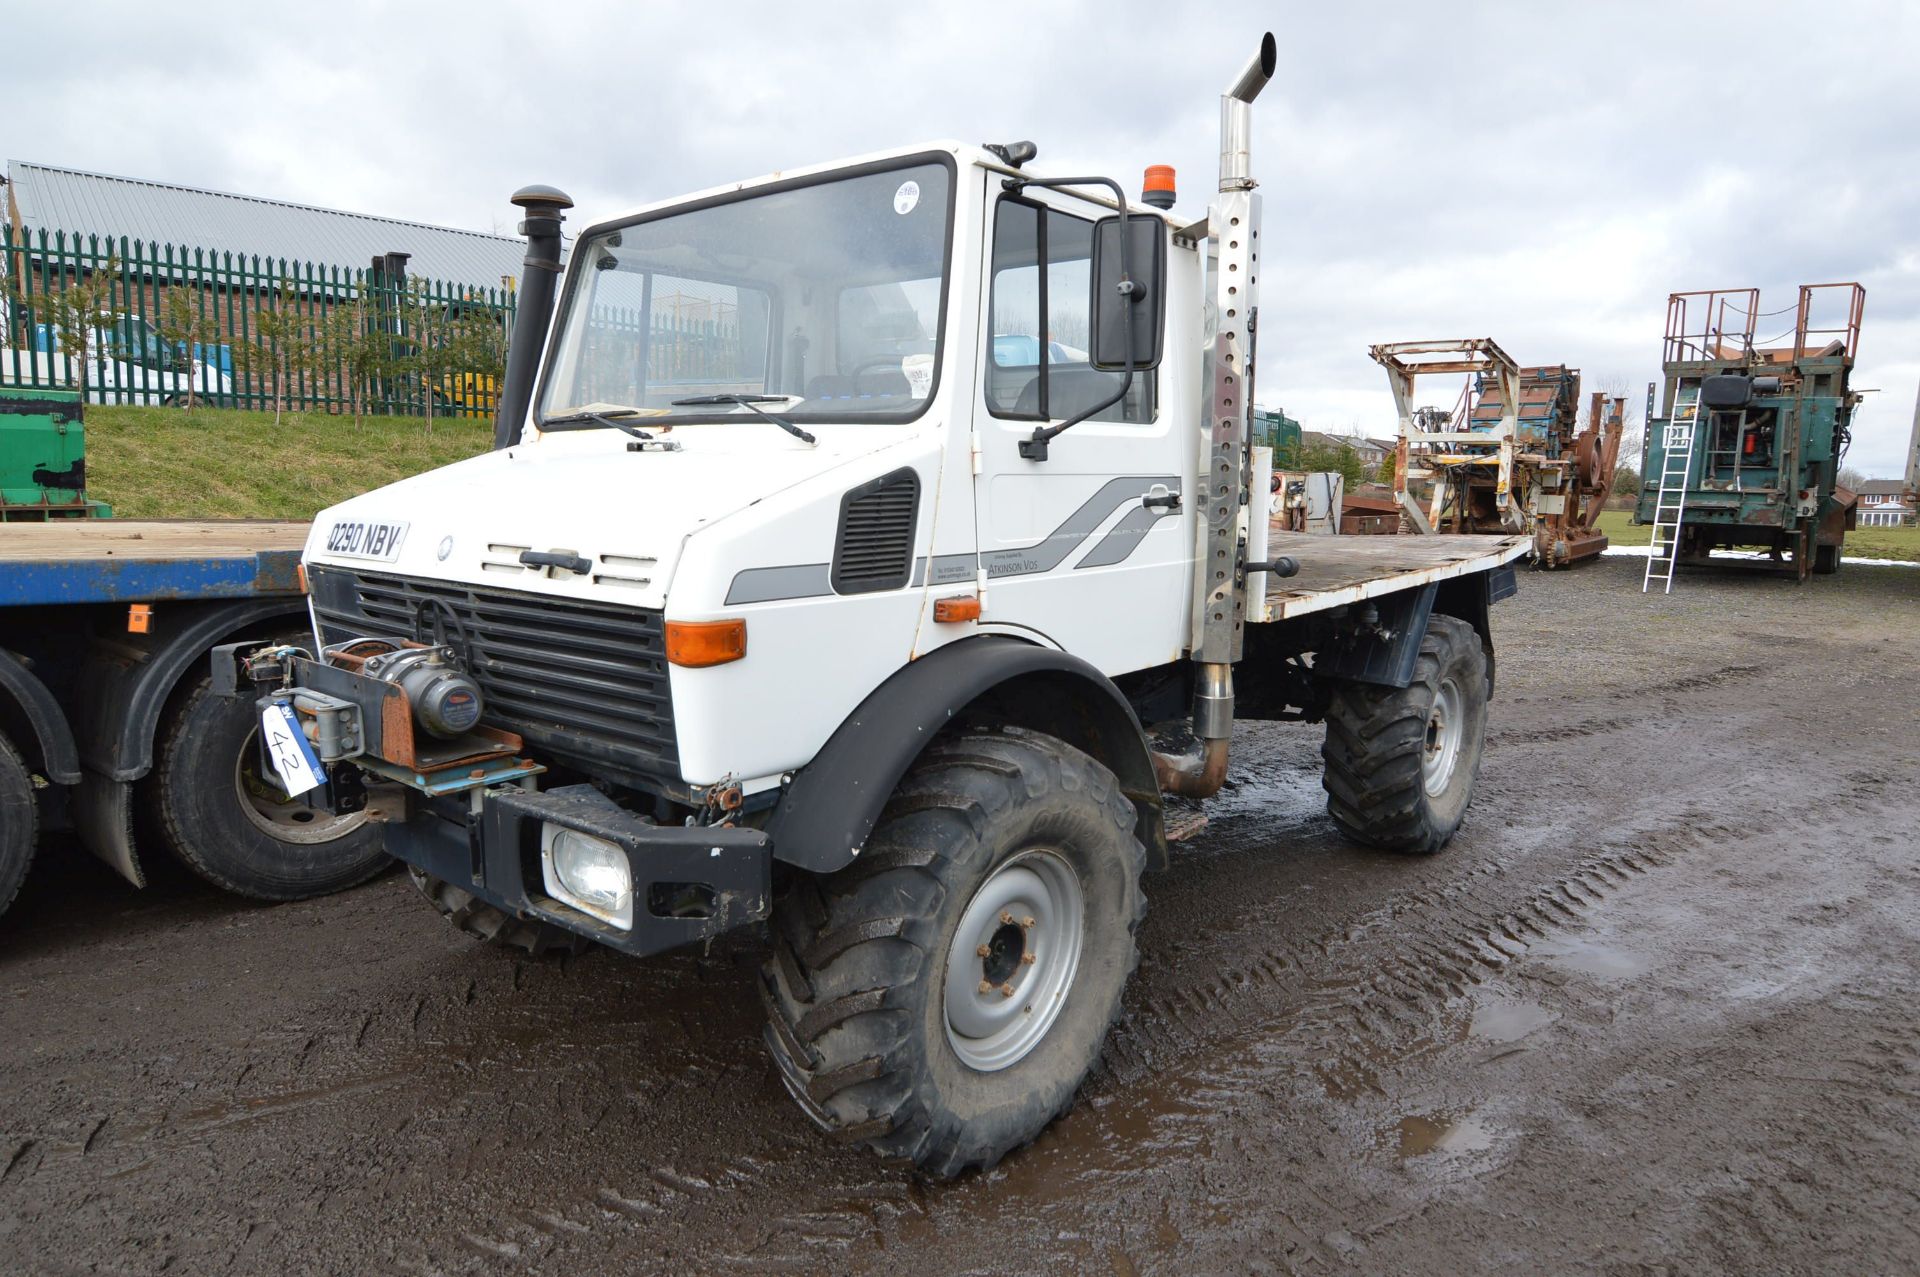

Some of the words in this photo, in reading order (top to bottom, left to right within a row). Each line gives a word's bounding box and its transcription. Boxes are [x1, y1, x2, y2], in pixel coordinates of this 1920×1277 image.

[327, 523, 363, 552] Q290
[361, 524, 401, 556] NBV
[989, 565, 1022, 576] ATKINSON
[272, 732, 299, 780] 42
